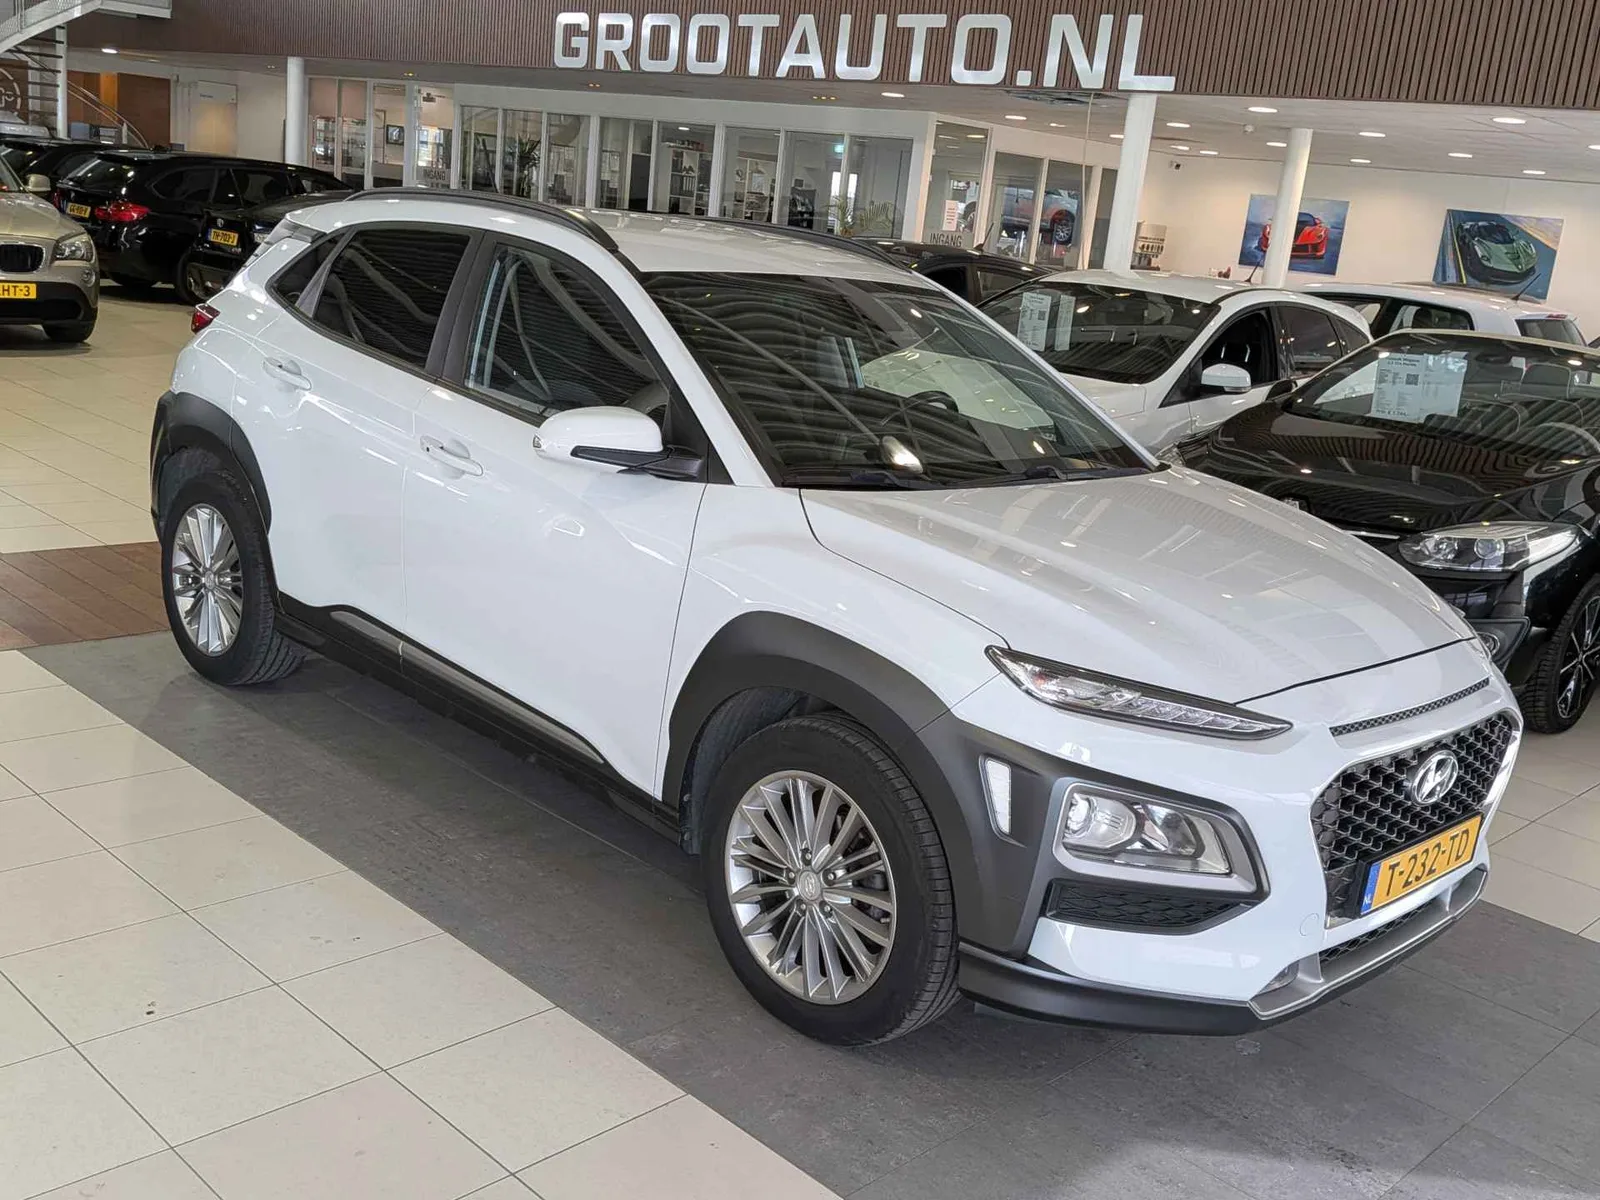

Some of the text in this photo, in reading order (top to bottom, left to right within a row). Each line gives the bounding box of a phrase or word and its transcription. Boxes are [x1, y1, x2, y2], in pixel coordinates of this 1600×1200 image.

[554, 12, 1176, 91] GROOTAUTO.NL
[930, 232, 962, 248] INGANG
[0, 284, 31, 297] HT-3
[1386, 829, 1469, 896] T-232-TD
